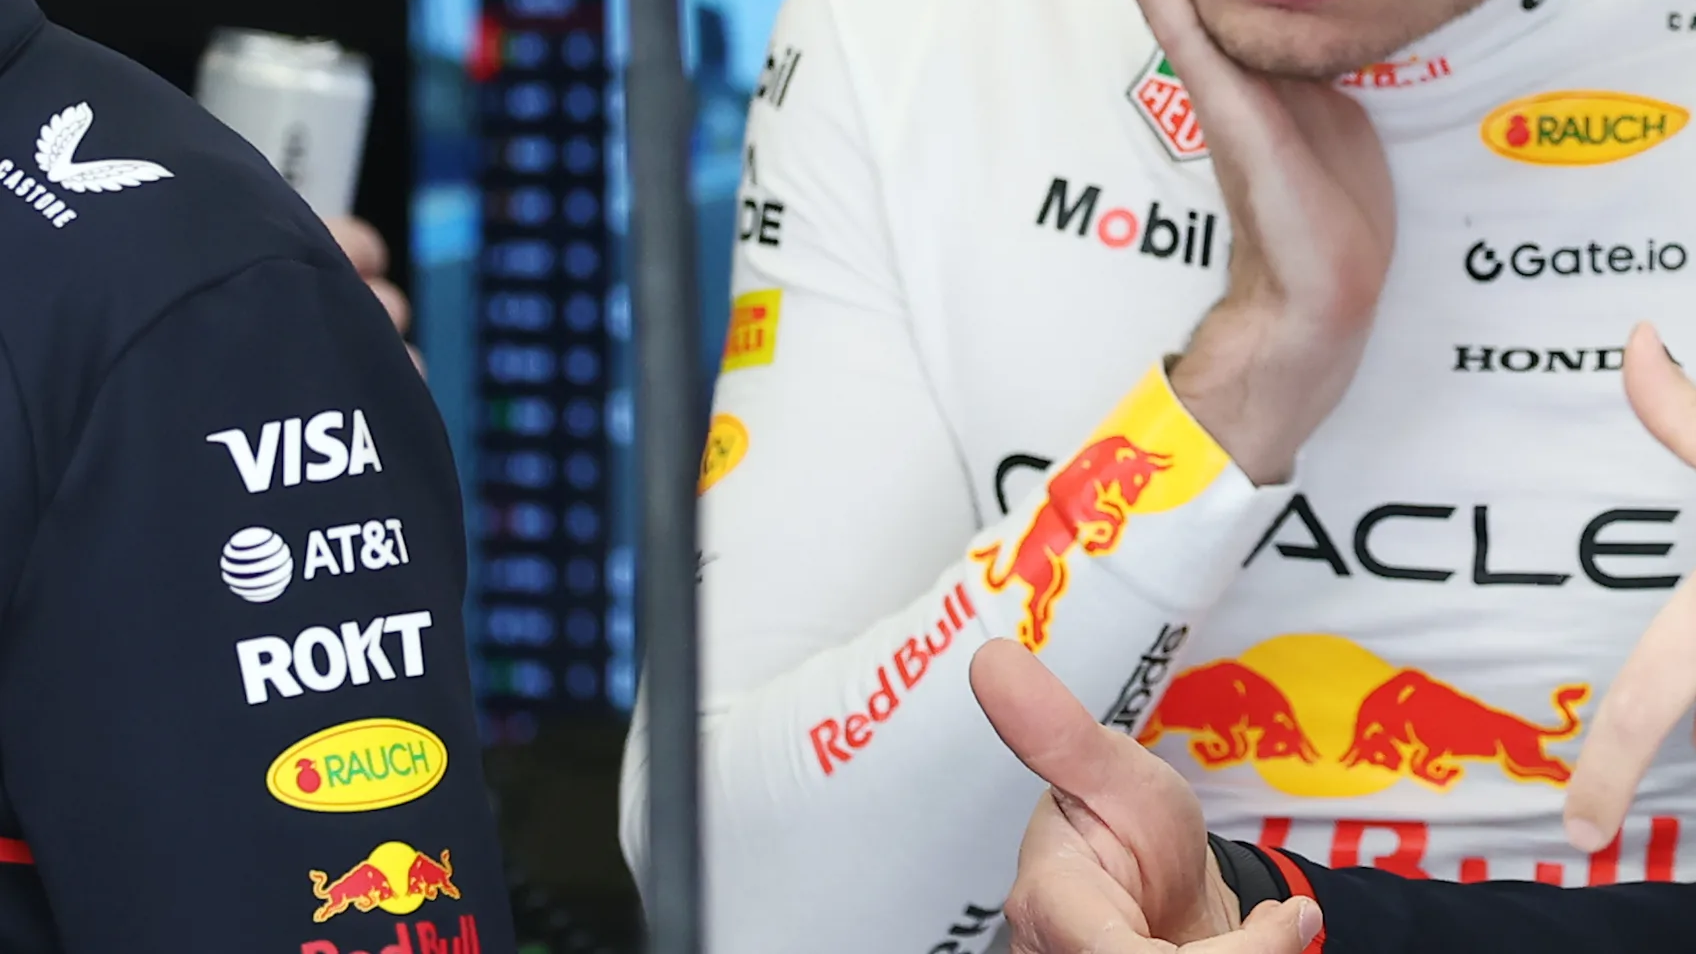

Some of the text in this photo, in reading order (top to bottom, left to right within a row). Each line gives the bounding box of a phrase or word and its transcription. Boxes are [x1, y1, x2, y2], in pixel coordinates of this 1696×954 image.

[1144, 81, 1206, 150] HEU
[1536, 114, 1667, 146] RAUCH
[0, 158, 78, 228] CASTORE
[1036, 177, 1215, 268] Mobil
[1510, 239, 1687, 278] Gate.io
[1451, 345, 1682, 373] HOND
[206, 409, 383, 493] VISA
[303, 518, 410, 581] AT&T
[236, 610, 433, 705] ROKT
[808, 581, 978, 777] Red Bull
[326, 744, 430, 788] RAUCH
